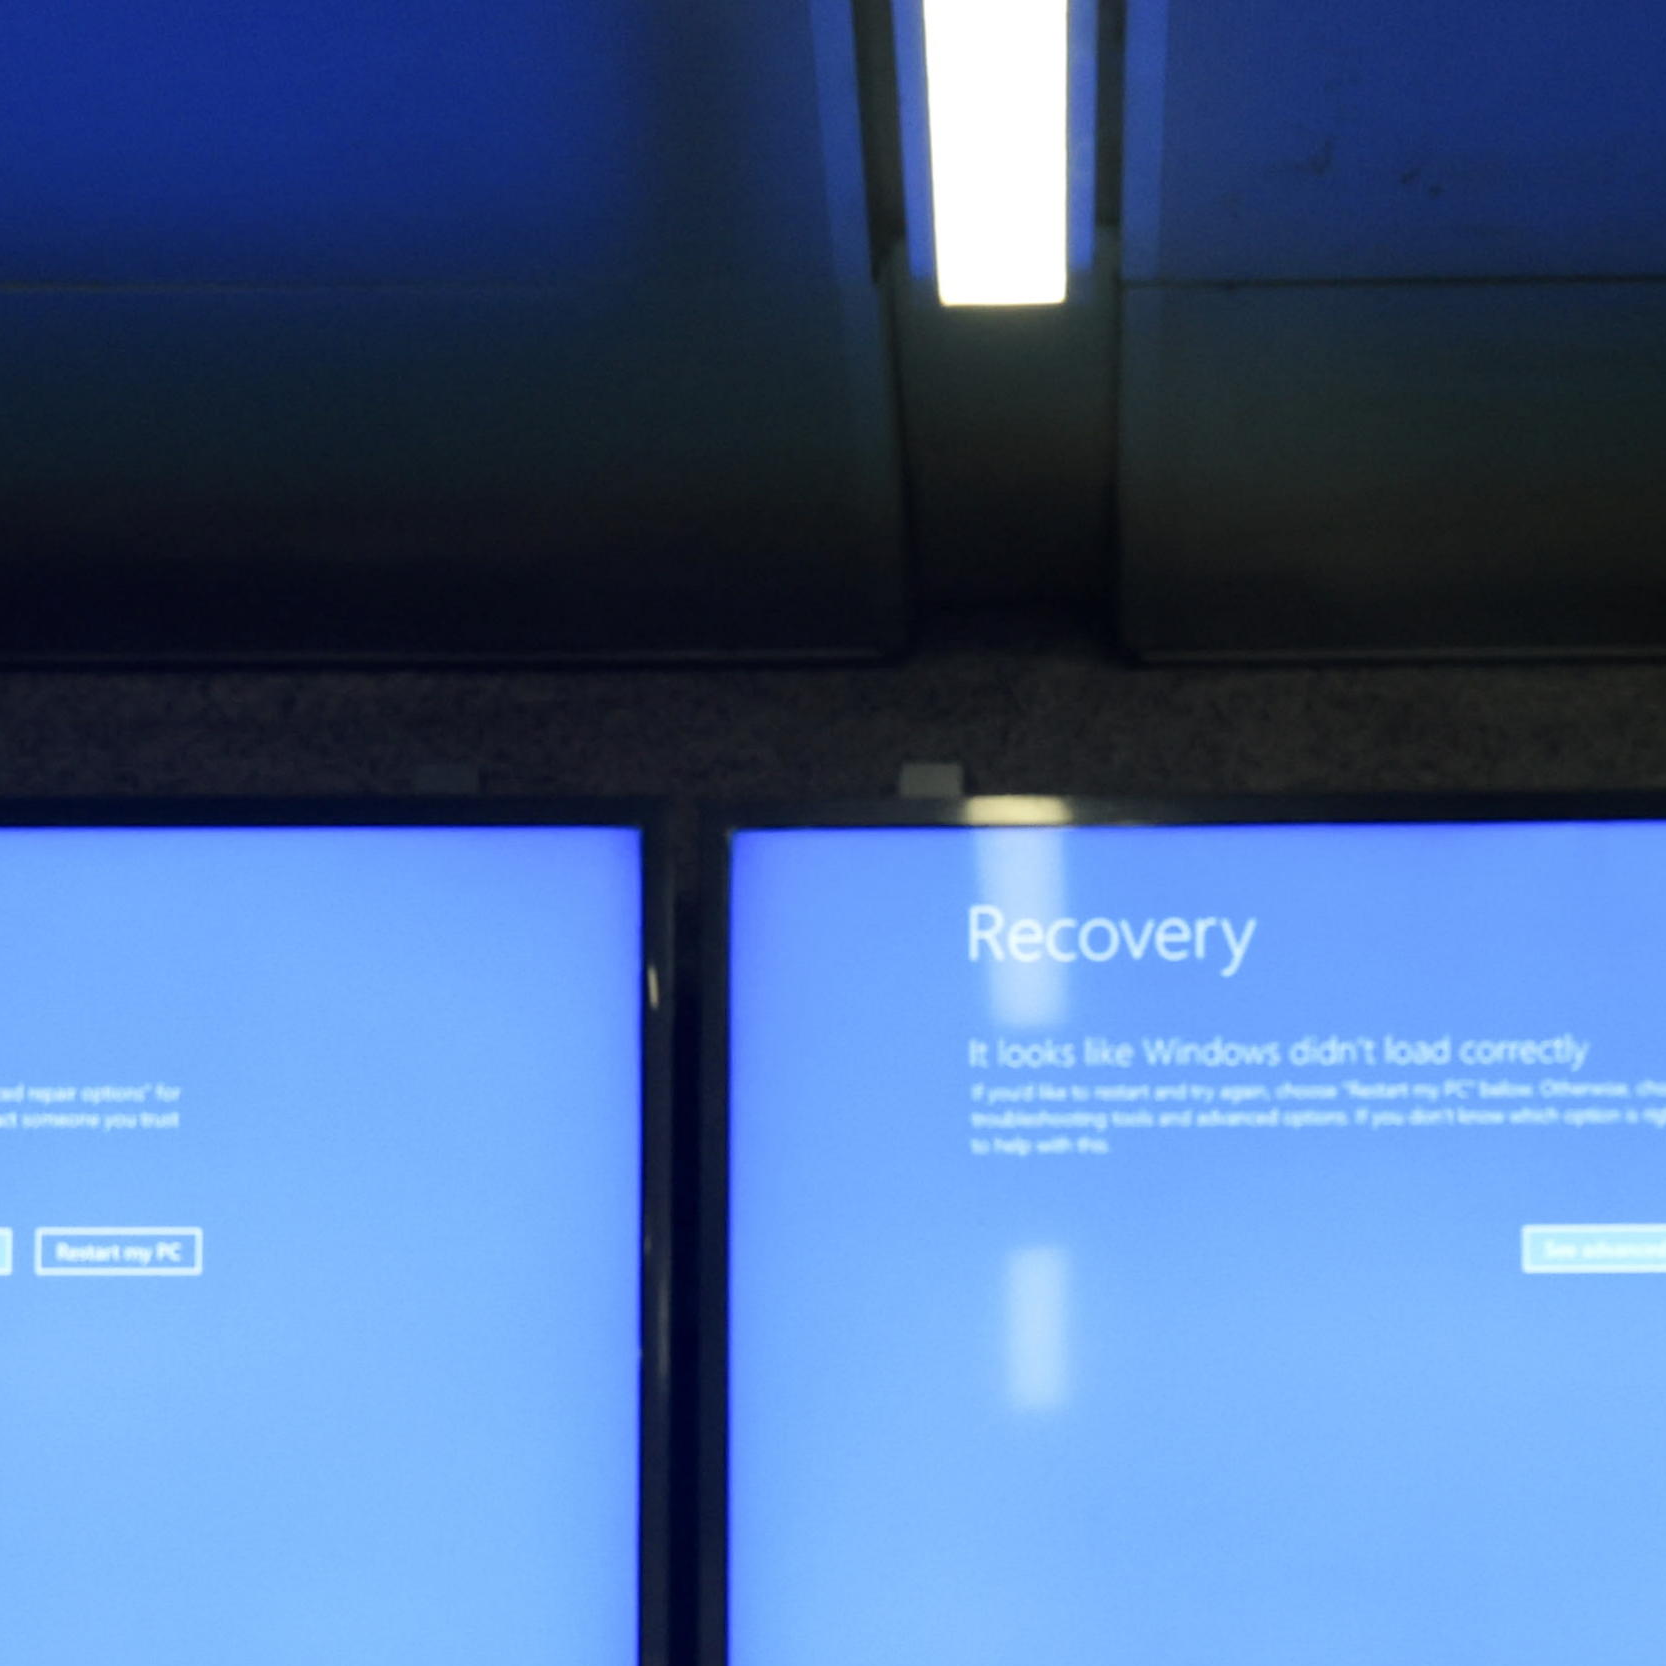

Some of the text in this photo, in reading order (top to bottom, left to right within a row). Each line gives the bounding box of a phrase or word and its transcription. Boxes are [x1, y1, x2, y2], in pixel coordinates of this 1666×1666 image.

[968, 904, 1258, 977] Recovery
[968, 1034, 1590, 1072] It looks like Windows didn't load correctly
[55, 1241, 121, 1262] Restart
[156, 1241, 182, 1262] PC
